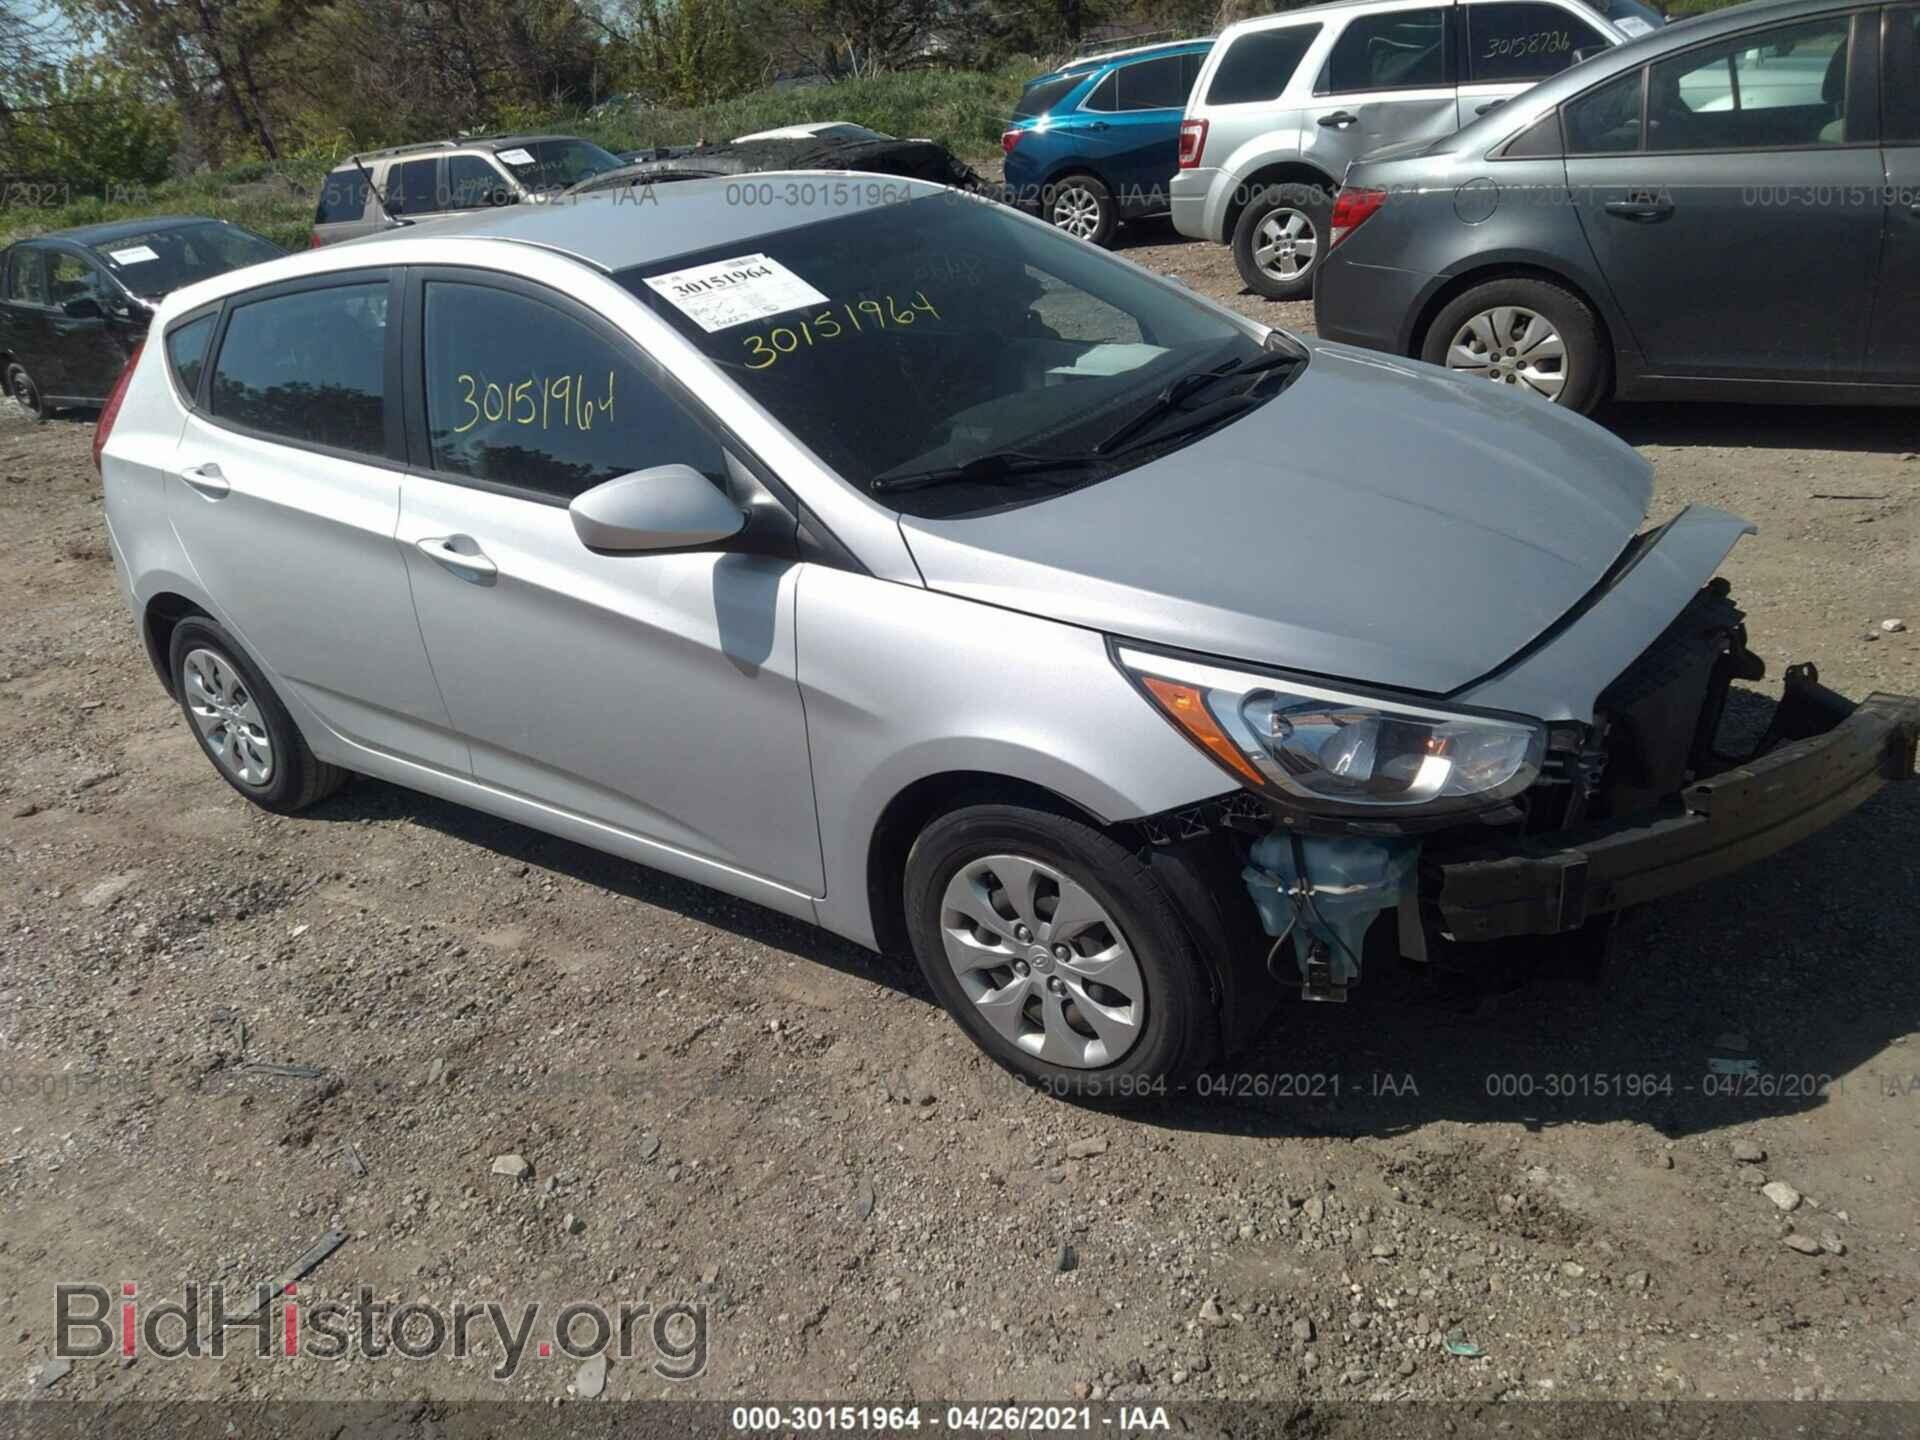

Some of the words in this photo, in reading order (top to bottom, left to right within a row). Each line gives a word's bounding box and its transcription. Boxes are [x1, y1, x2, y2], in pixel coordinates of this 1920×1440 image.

[672, 265, 773, 297] 30151964
[744, 290, 941, 370] 30151964
[453, 370, 615, 432] 30151964
